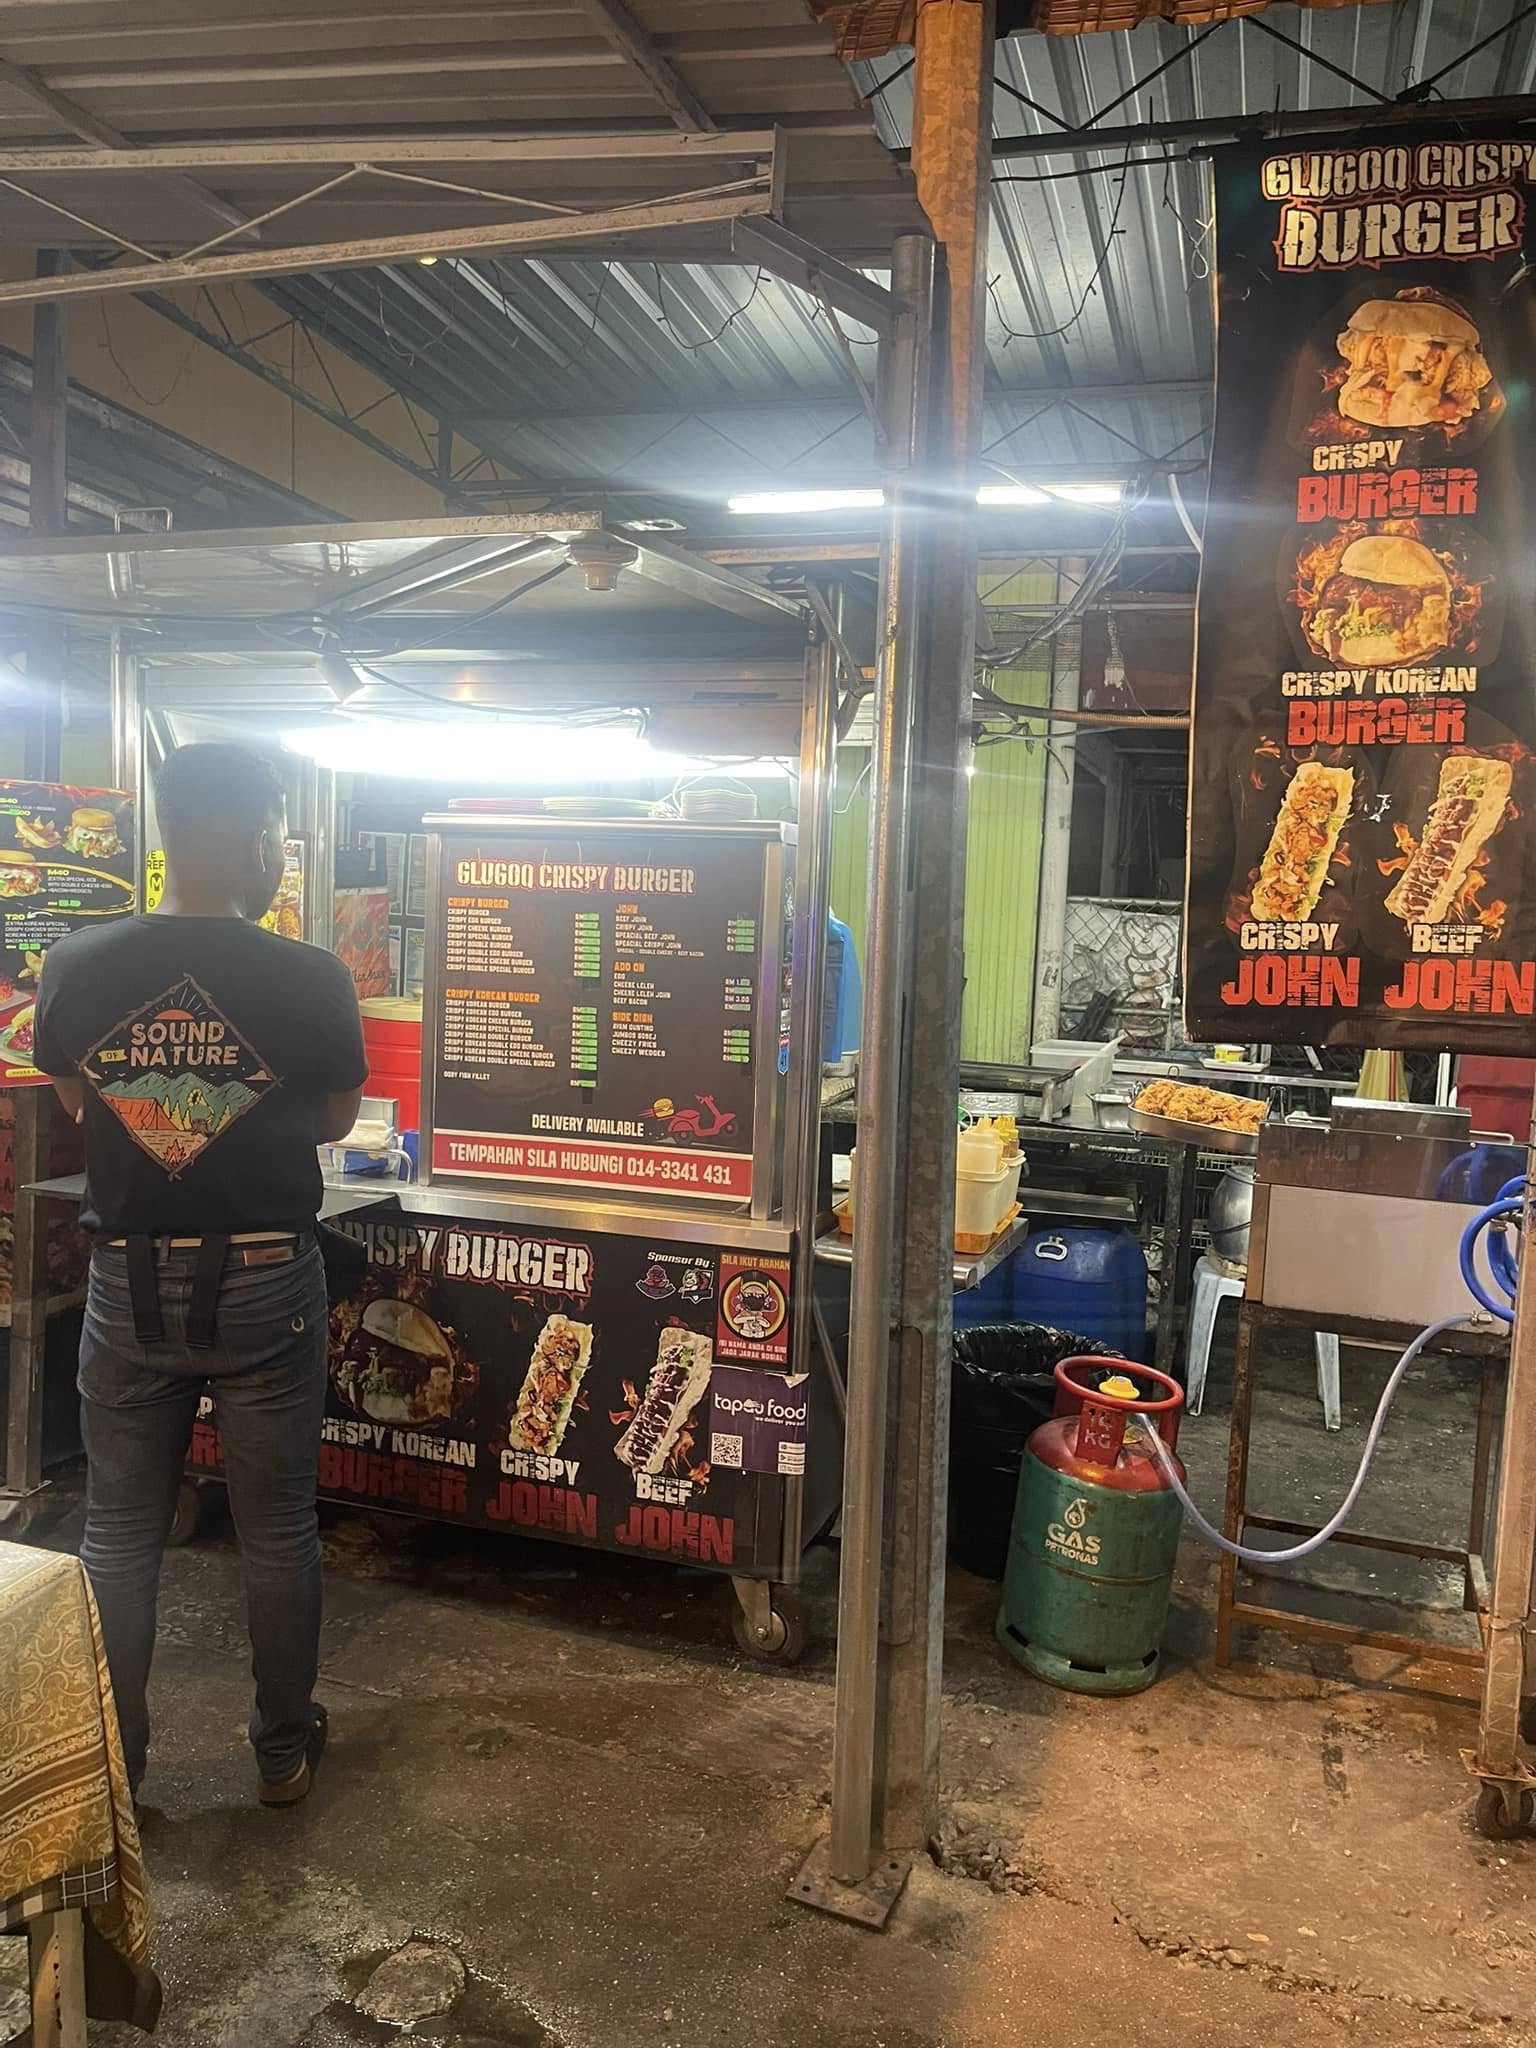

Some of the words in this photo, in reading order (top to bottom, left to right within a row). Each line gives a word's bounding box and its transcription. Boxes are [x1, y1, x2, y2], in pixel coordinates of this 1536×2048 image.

[1283, 193, 1516, 266] BURGER
[1313, 439, 1403, 472] CRISPY
[1297, 467, 1478, 523] BURGER
[1281, 668, 1369, 697] CRISPY
[1375, 666, 1477, 696] KOREAN
[1287, 696, 1466, 746] BURGER
[540, 864, 608, 890] CRISPY
[613, 867, 694, 893] BURGER
[448, 898, 476, 907] CRISPY
[478, 899, 509, 909] BURGER
[616, 904, 638, 914] JOHN
[1240, 921, 1339, 951] CRISPY
[1412, 923, 1483, 954] BEEF
[614, 962, 631, 972] ADD
[633, 963, 645, 972] ON
[1221, 955, 1361, 1008] JOHN
[446, 989, 474, 999] CRISPY
[476, 990, 507, 1001] KOREAN
[508, 992, 540, 1002] BURGER
[1384, 959, 1536, 1014] JOHN
[613, 1012, 631, 1022] SIDE
[131, 1021, 225, 1046] SOUND
[130, 1045, 239, 1067] NATURE
[532, 1114, 583, 1133] DELIVERY
[586, 1116, 644, 1137] AVAILABLE
[450, 1143, 523, 1166] TEMPAHAN
[527, 1148, 557, 1169] SILA
[561, 1151, 623, 1175] HUBUNGI
[627, 1160, 698, 1182] 014-3341
[703, 1166, 731, 1185] 431
[447, 1232, 589, 1292] BURGER
[647, 1251, 692, 1266] Sponsor
[695, 1259, 710, 1268] By
[721, 1255, 737, 1265] SILA
[739, 1256, 757, 1267] IKUT
[759, 1259, 790, 1270] ARAHAN
[768, 1399, 806, 1420] food
[392, 1429, 476, 1468] KOREAN
[319, 1444, 466, 1512] BURGER
[501, 1449, 580, 1485] CRISPY
[636, 1472, 693, 1506] BEEF
[485, 1481, 597, 1538] JOHN
[614, 1505, 734, 1565] JOHN
[1048, 1523, 1101, 1554] GAS
[1045, 1539, 1098, 1566] PETRONAS
